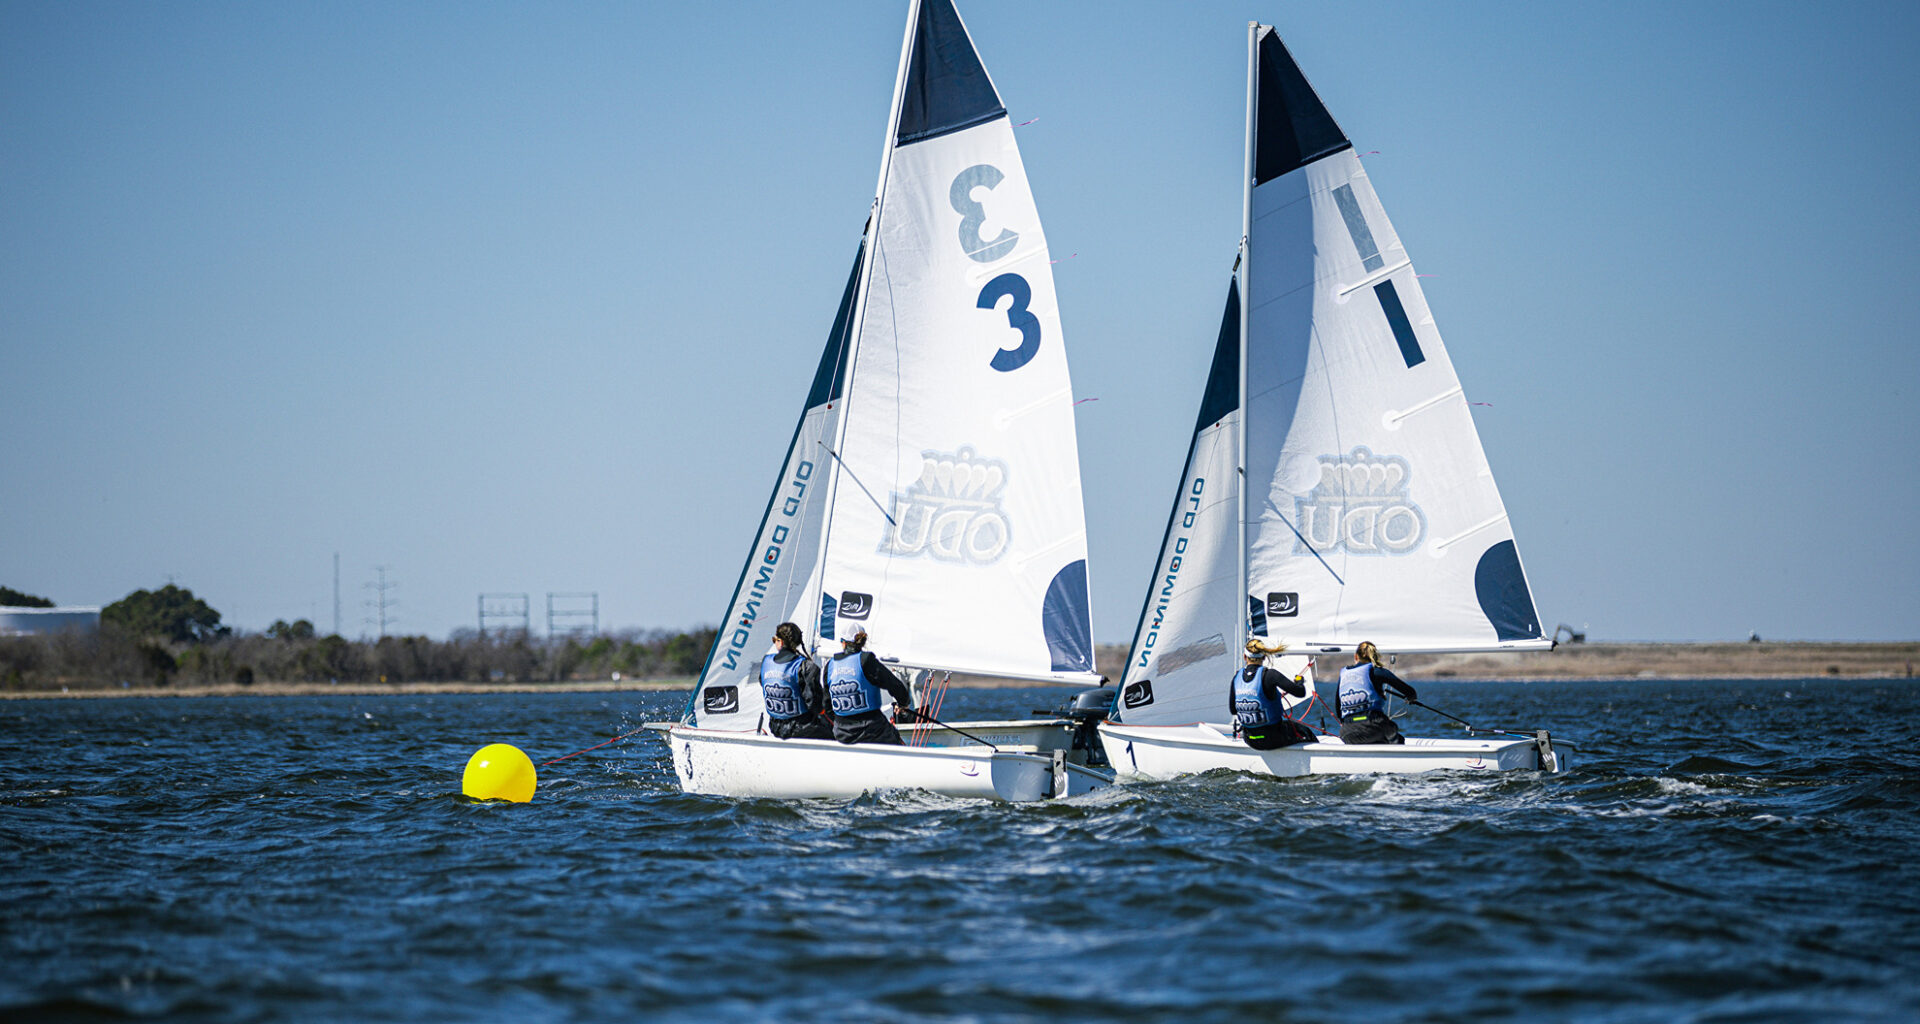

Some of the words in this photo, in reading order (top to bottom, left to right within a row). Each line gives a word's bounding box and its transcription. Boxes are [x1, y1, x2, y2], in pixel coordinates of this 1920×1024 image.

[976, 272, 1042, 372] 3
[1373, 279, 1426, 368] 1
[765, 697, 799, 715] ODU
[831, 692, 867, 712] ODU
[1126, 740, 1138, 771] 1
